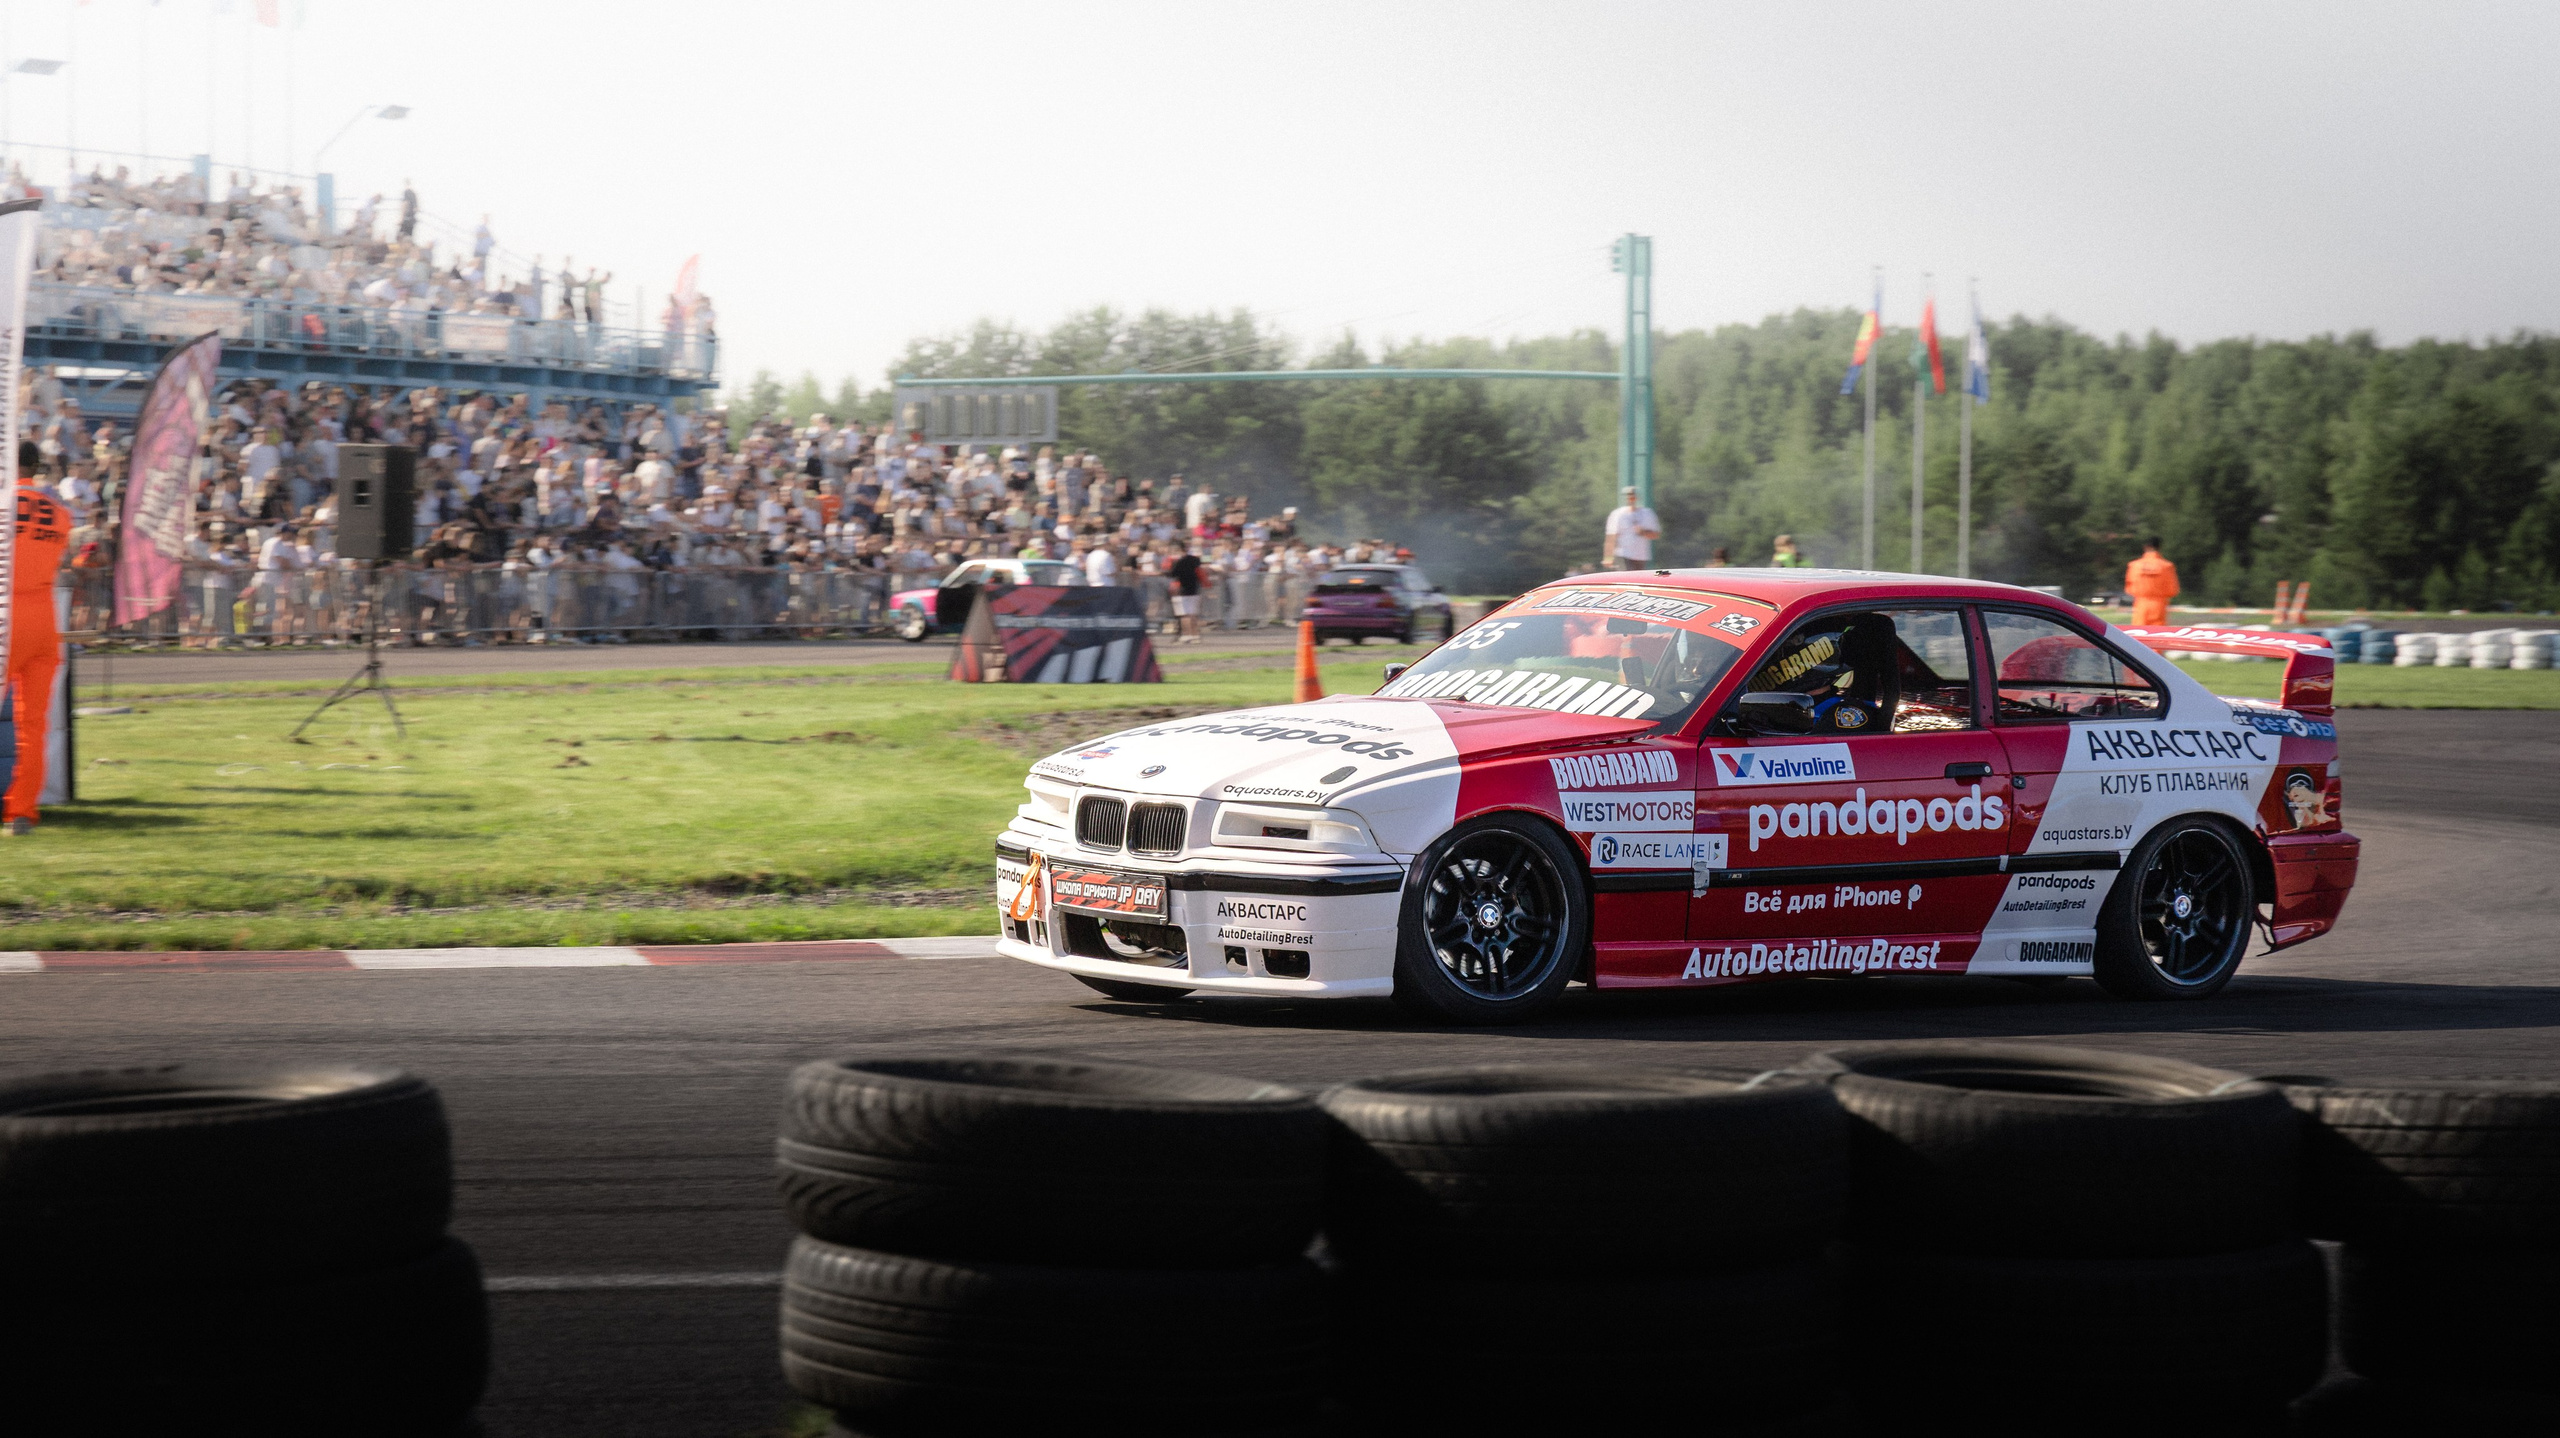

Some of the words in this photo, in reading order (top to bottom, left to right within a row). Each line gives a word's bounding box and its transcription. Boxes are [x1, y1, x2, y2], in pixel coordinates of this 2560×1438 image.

[1316, 718, 1395, 732] iPhone
[2087, 729, 2268, 762] АКВАСТАРС
[1548, 750, 1679, 790] BOOGABAND
[1759, 757, 1847, 778] Valvoline
[1223, 783, 1329, 804] aquastars.by
[2101, 774, 2152, 795] КЛУБ
[2157, 772, 2249, 792] ПЛАВАНИЯ
[1565, 801, 1694, 822] WESTMOTORS
[1749, 783, 2005, 852] pandapods
[1621, 843, 1661, 859] RACE
[1665, 843, 1705, 859] LANE
[2017, 873, 2096, 892] pandapods
[1118, 885, 1132, 903] JP
[1134, 887, 1162, 907] DAY
[1744, 890, 1782, 914] Всё
[1786, 895, 1826, 915] для
[1833, 886, 1902, 908] iPhone
[2002, 899, 2087, 912] AutoDetailingBrest
[1217, 902, 1307, 921] АКВАСТАРС
[1217, 928, 1314, 945] AutoDetailingBrest
[1682, 939, 1940, 979] AutoDetailingBrest
[2020, 941, 2093, 963] BOOGABAND
